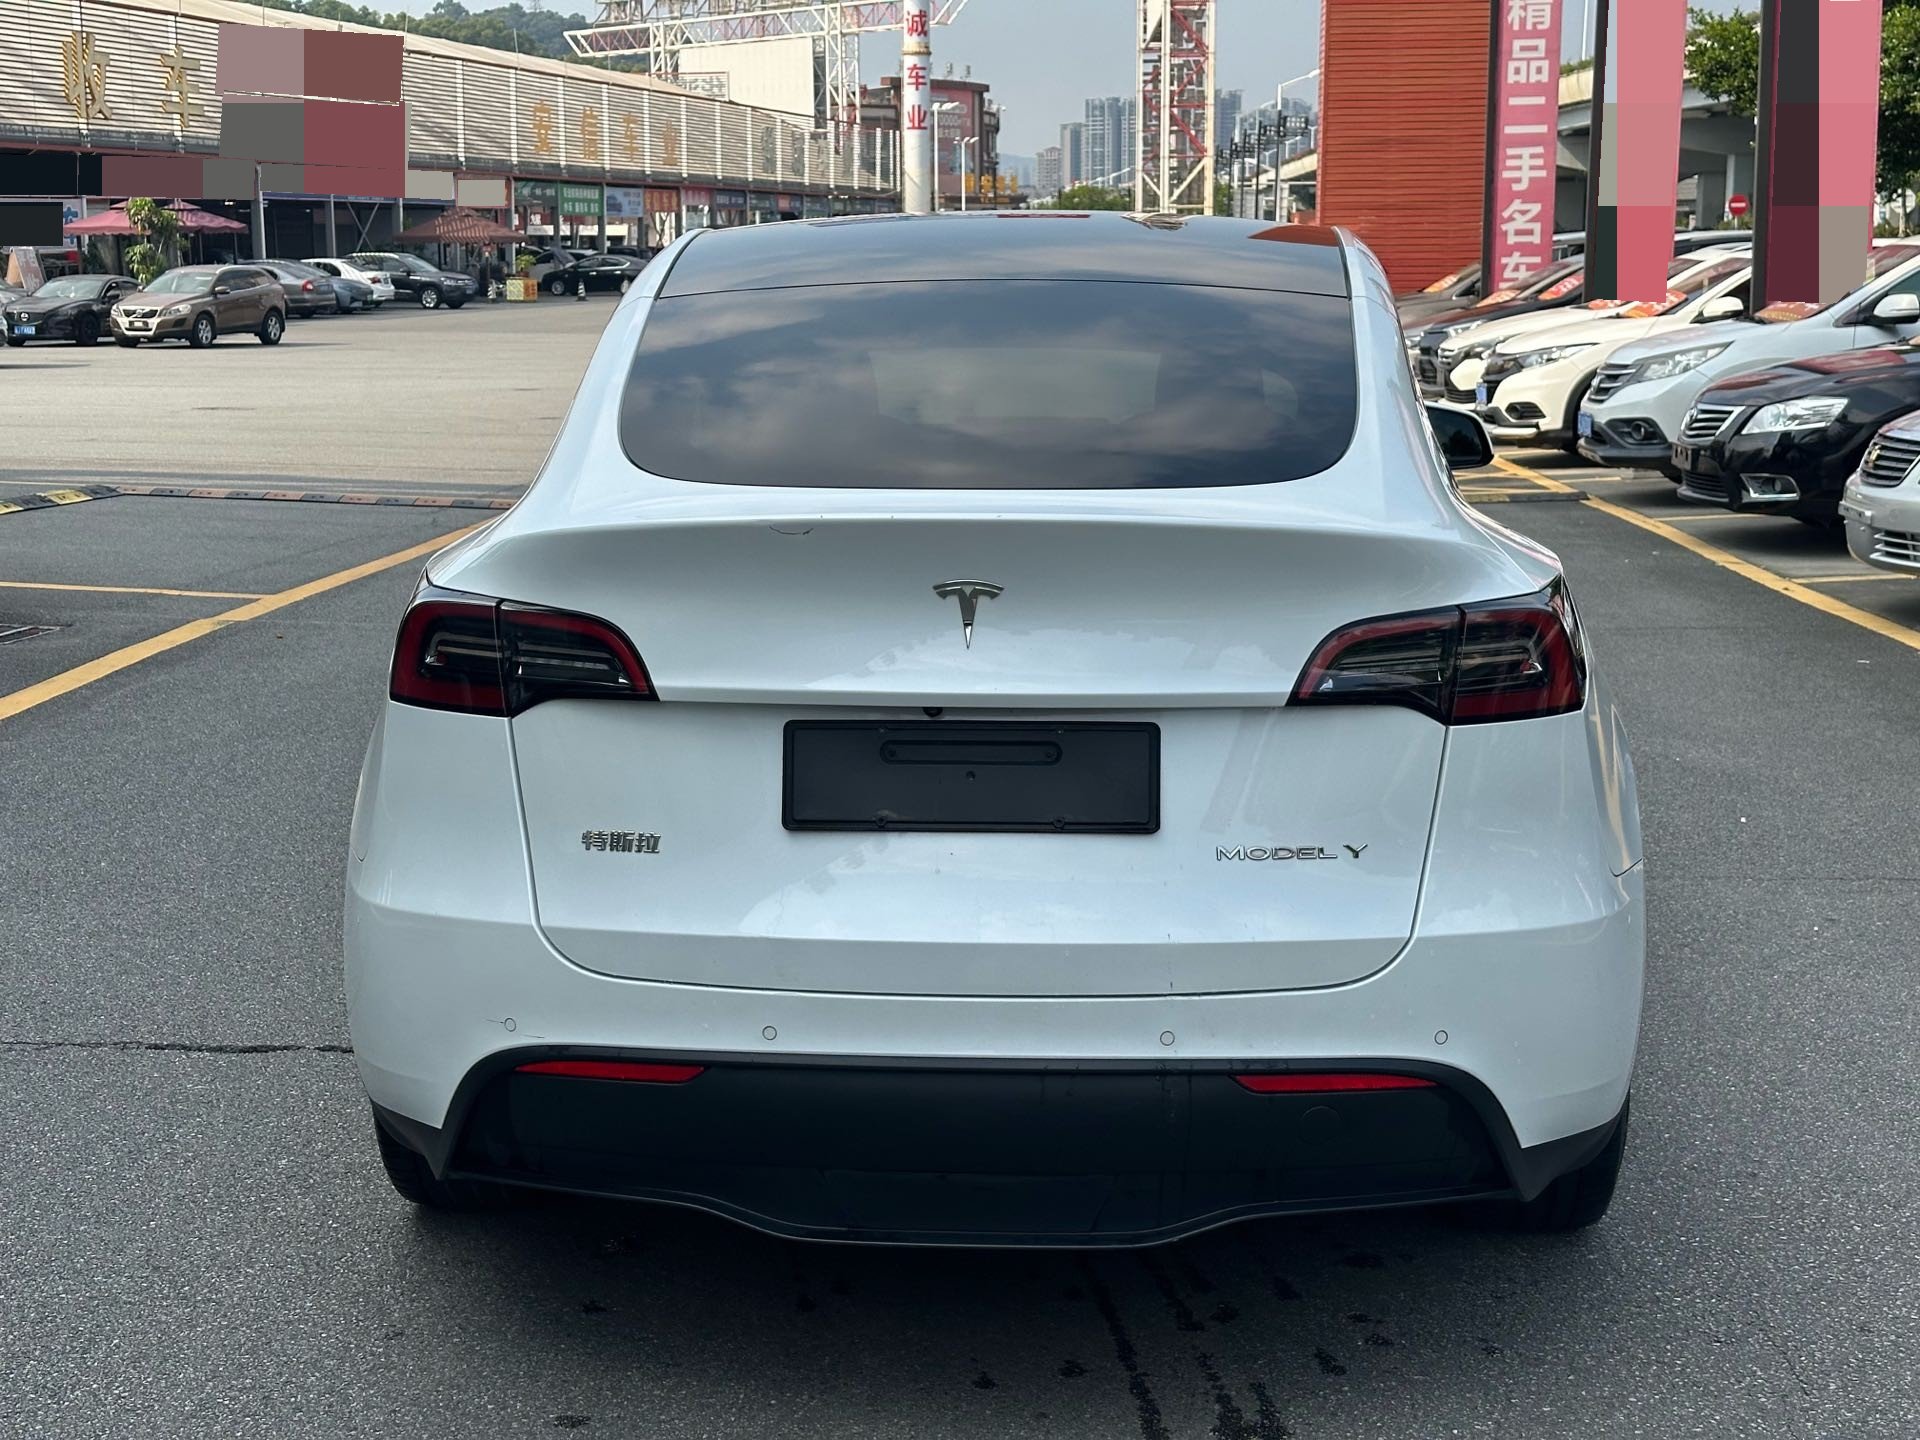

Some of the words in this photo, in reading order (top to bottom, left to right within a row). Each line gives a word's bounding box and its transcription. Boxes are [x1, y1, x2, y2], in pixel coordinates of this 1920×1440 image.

[906, 9, 928, 130] 诚车业
[581, 830, 661, 853] 特斯拉
[1216, 844, 1338, 861] MODEL
[1343, 843, 1368, 859] Y
